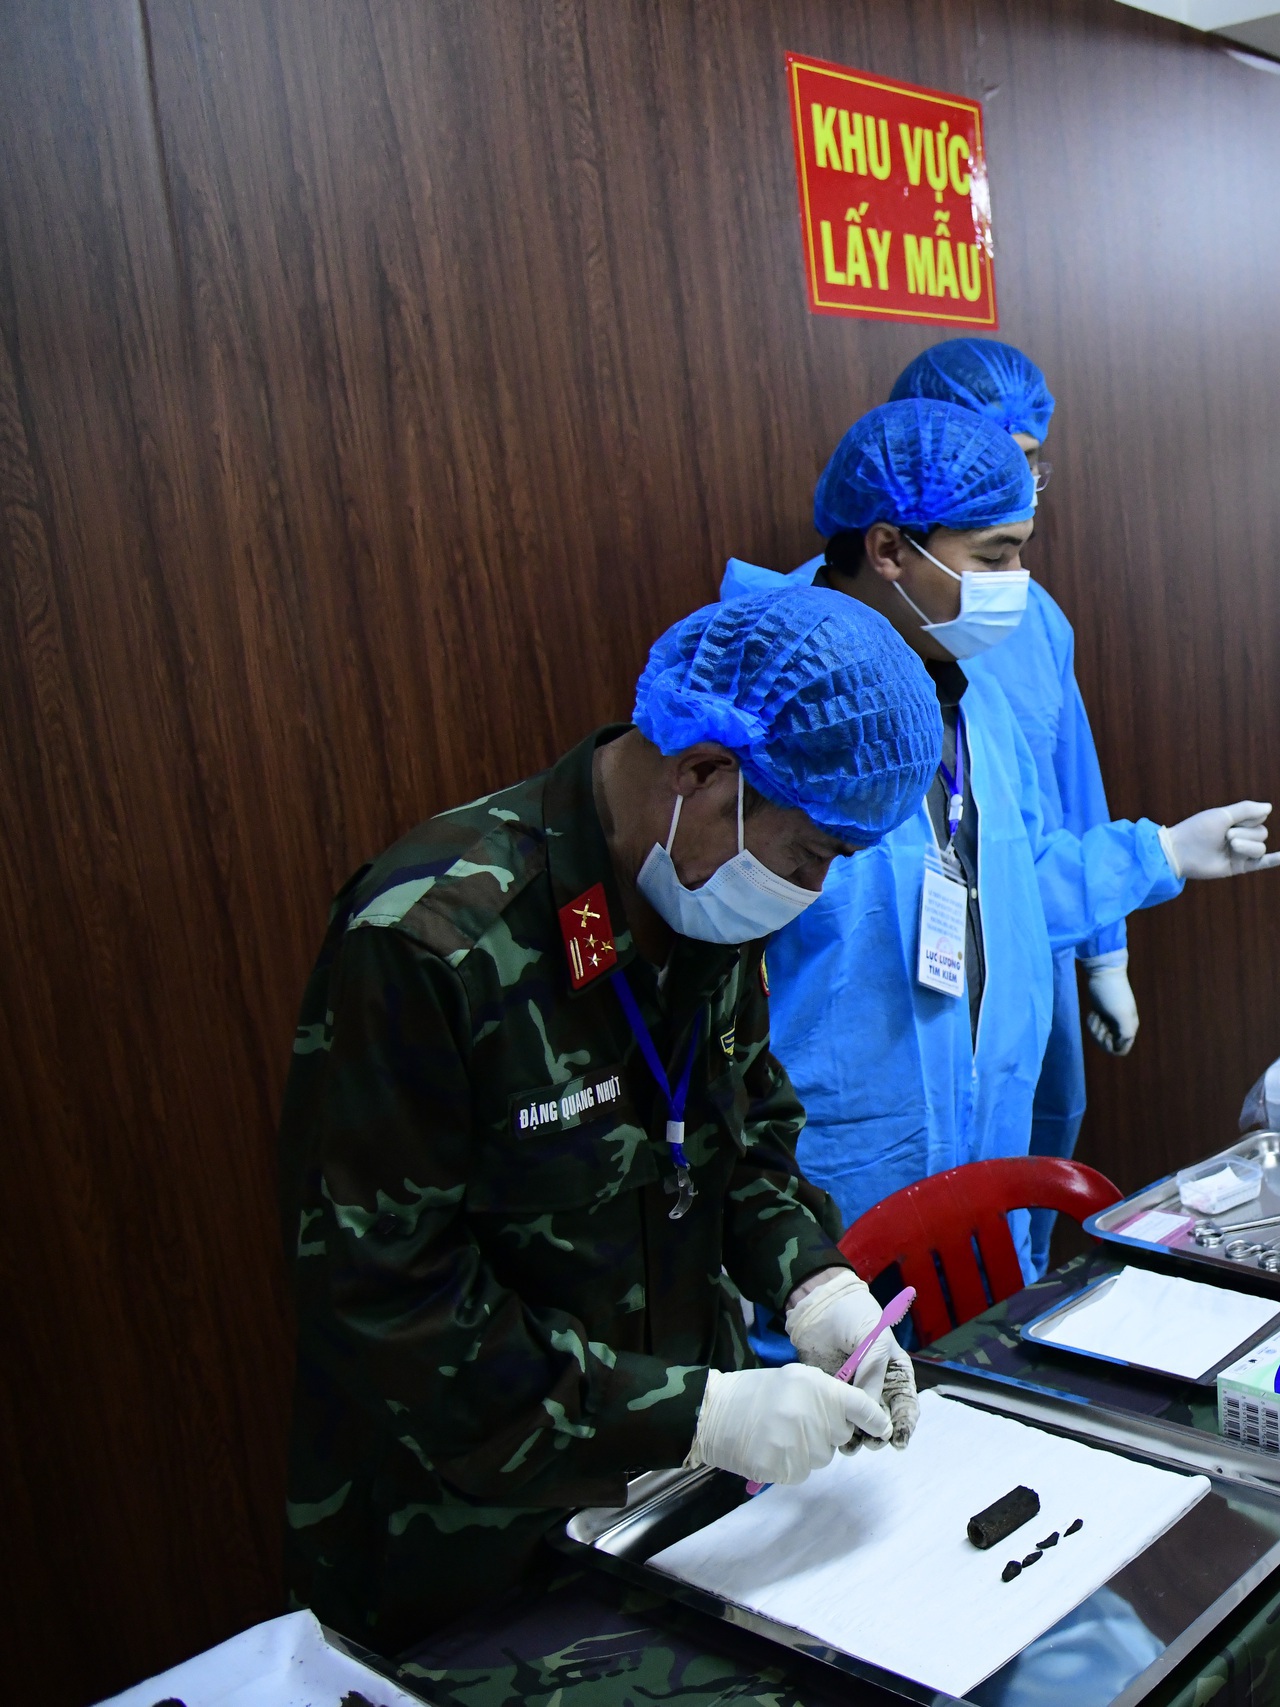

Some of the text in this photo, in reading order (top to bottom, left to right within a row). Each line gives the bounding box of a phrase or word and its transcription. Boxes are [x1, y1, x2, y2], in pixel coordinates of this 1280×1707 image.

[811, 103, 971, 203] KHU VỰC
[820, 202, 982, 302] LẤY MẪU
[519, 1102, 558, 1130] ĐẶNG
[561, 1087, 595, 1120] QUANG
